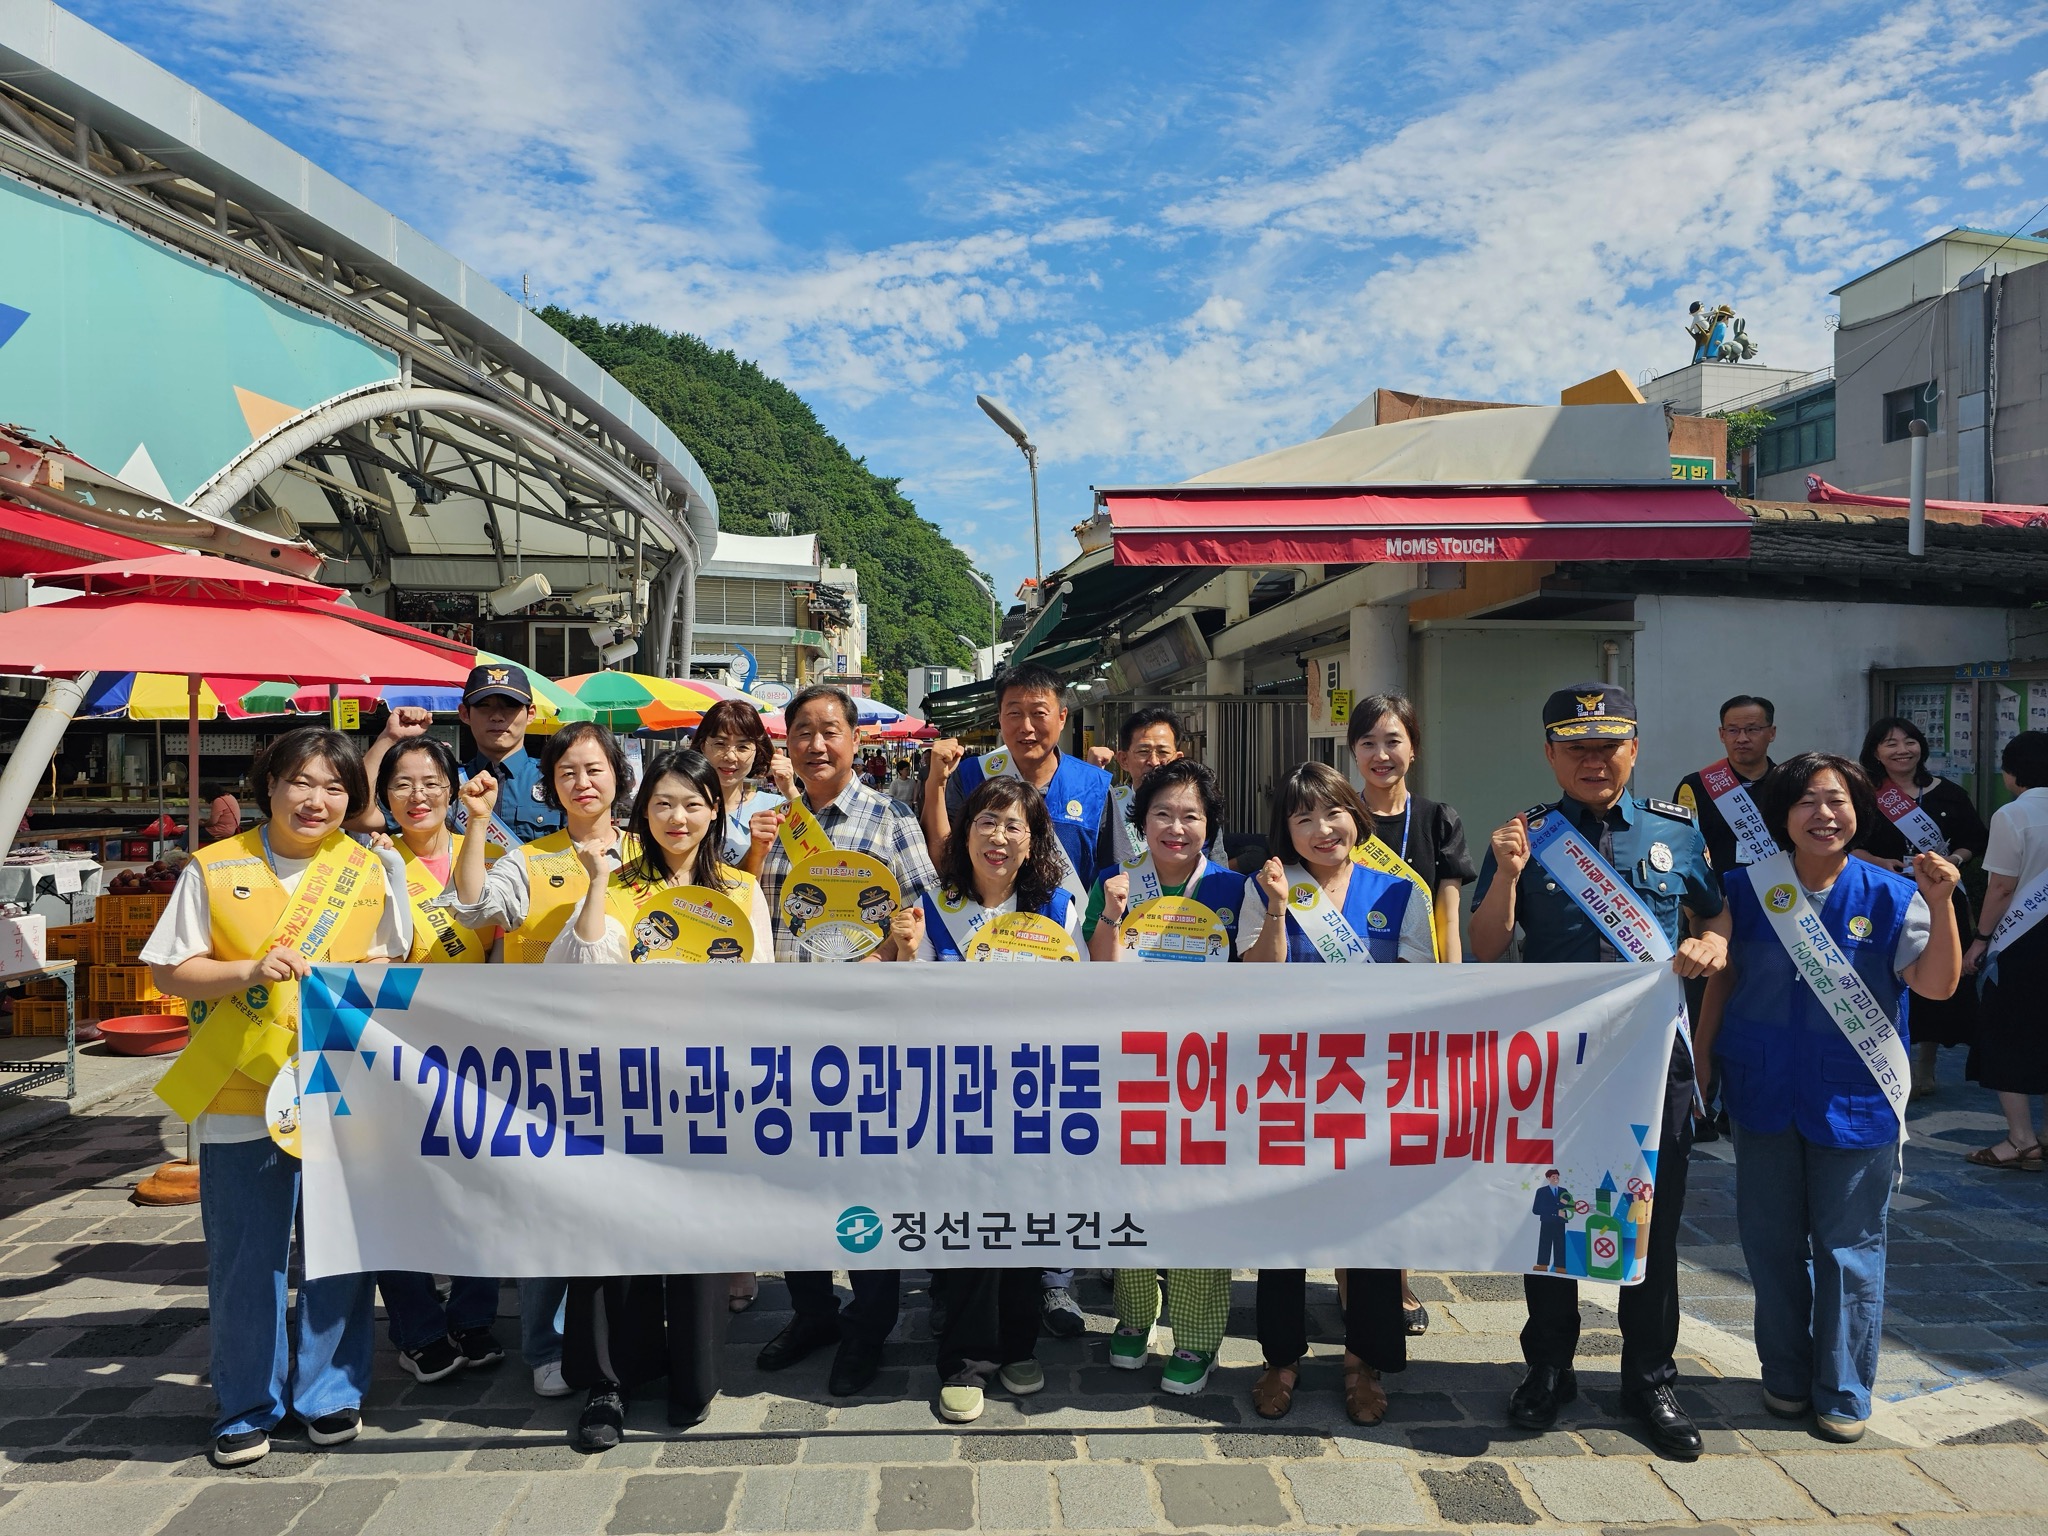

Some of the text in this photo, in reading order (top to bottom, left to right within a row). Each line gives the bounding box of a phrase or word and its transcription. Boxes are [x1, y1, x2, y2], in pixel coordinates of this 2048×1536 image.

[1963, 666, 2001, 677] 게시판
[767, 691, 788, 700] 화장실
[1576, 702, 1606, 713] 경찰
[1711, 776, 1735, 793] 마약!
[1732, 793, 1767, 833] 비타민이
[1888, 800, 1912, 816] 마약!
[348, 846, 368, 868] 담배
[810, 866, 873, 877] 3대 기초질서 준수
[1364, 842, 1391, 867] 판매할
[301, 862, 335, 905] 청소년을
[334, 866, 360, 896] 판매할
[672, 898, 687, 909] 3대
[687, 903, 718, 920] 기초질서
[718, 915, 735, 927] 준수
[1580, 887, 1621, 929] 모두의
[1322, 910, 1364, 957] 법질서
[1992, 909, 2024, 943] 우리학교
[13, 924, 23, 963] 오미자
[1799, 913, 1845, 968] 법질서
[1838, 973, 1895, 1044] 확립으로
[230, 994, 264, 1028] 정선군보건소
[1791, 941, 1837, 995] 공정한
[1833, 998, 1866, 1034] 사회
[1858, 1036, 1905, 1103] 만들어요
[809, 1044, 998, 1157] 유관기관
[1011, 1042, 1102, 1156] 합동
[891, 1211, 1148, 1253] 정선군보건소
